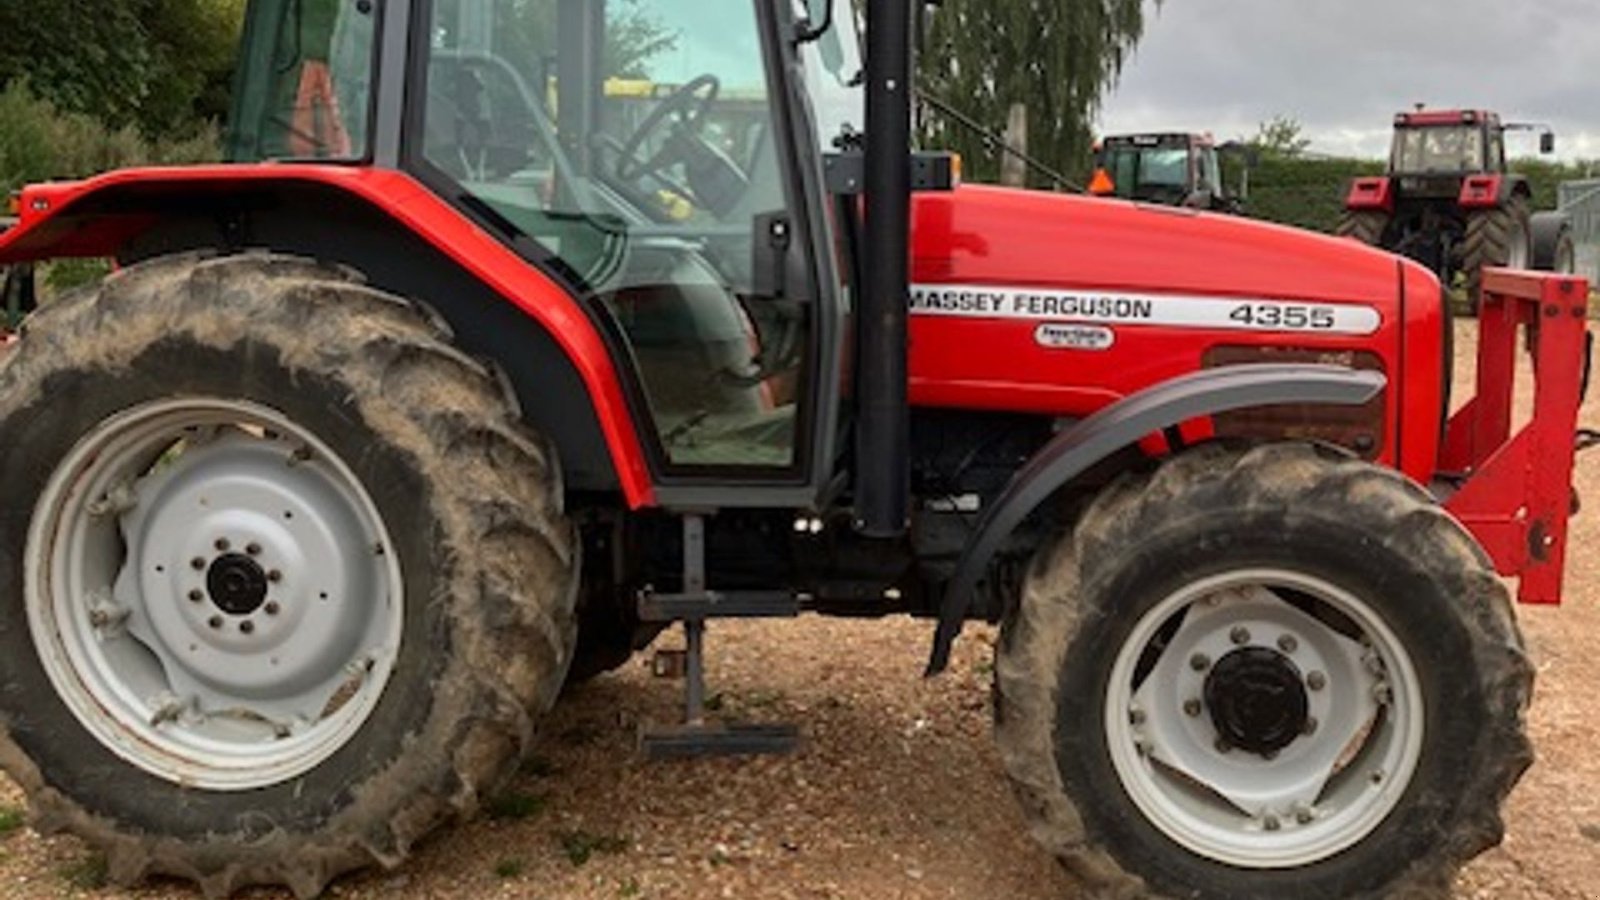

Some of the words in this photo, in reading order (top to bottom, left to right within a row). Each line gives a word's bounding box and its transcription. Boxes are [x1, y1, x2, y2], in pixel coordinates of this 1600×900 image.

[908, 290, 1003, 311] MASSEY
[1014, 294, 1152, 318] FERGUSON
[1229, 304, 1335, 329] 4355
